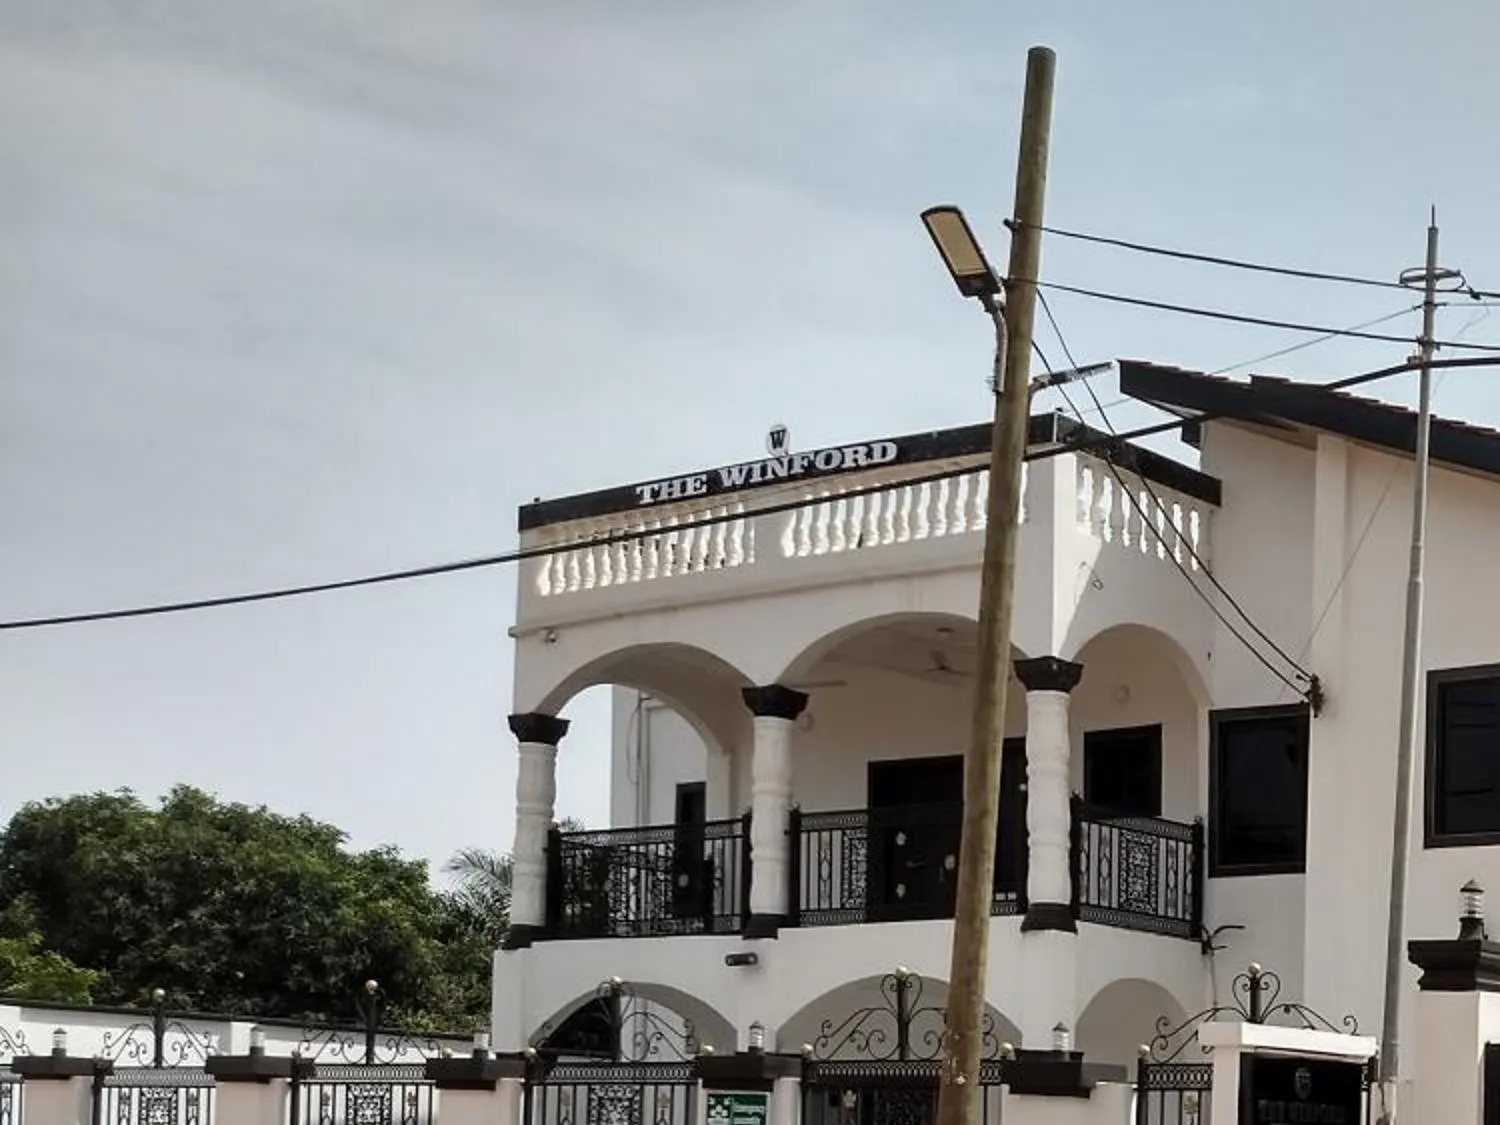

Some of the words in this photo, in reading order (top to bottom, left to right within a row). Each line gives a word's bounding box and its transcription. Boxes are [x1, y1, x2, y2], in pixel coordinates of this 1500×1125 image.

[769, 428, 787, 448] W
[636, 473, 707, 505] THE
[718, 441, 899, 488] WINFORD
